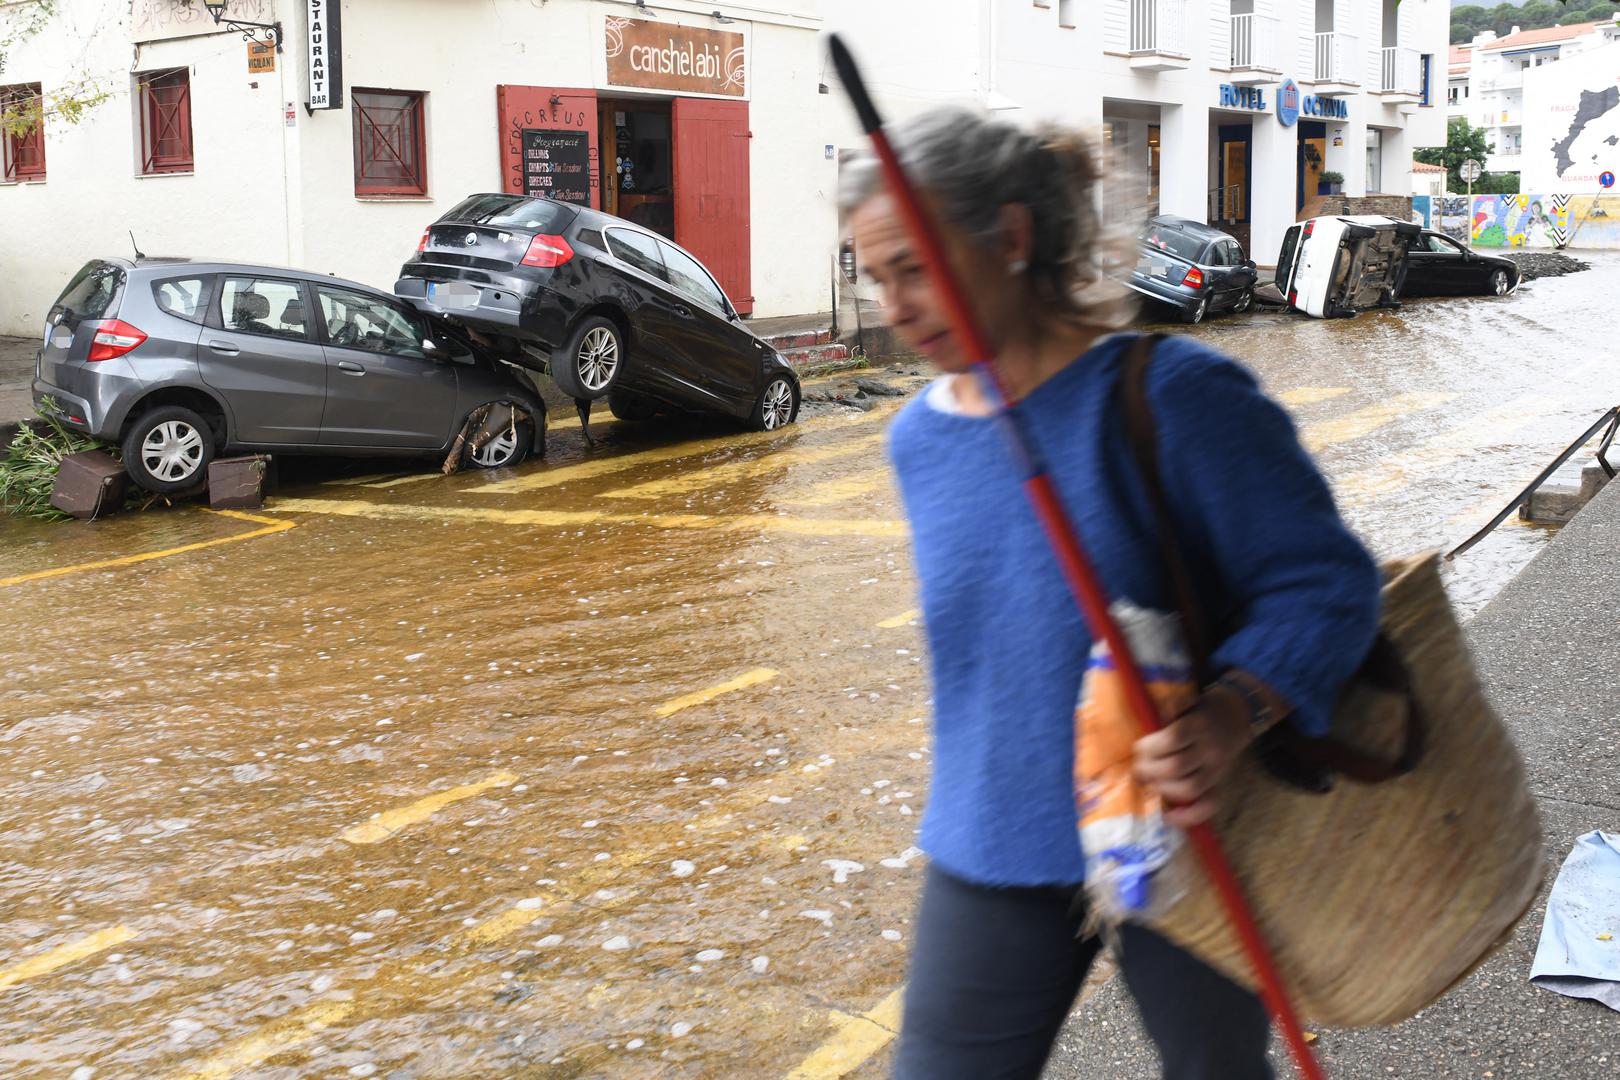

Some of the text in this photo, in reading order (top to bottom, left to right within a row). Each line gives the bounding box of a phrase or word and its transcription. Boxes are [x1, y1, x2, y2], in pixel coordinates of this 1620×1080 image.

[248, 56, 275, 69] VIGILANT
[629, 38, 721, 79] canshelabi
[311, 95, 327, 105] BAR
[1219, 83, 1267, 111] HOTEL
[1303, 95, 1349, 119] OCTAVIA
[524, 108, 585, 127] CREUS
